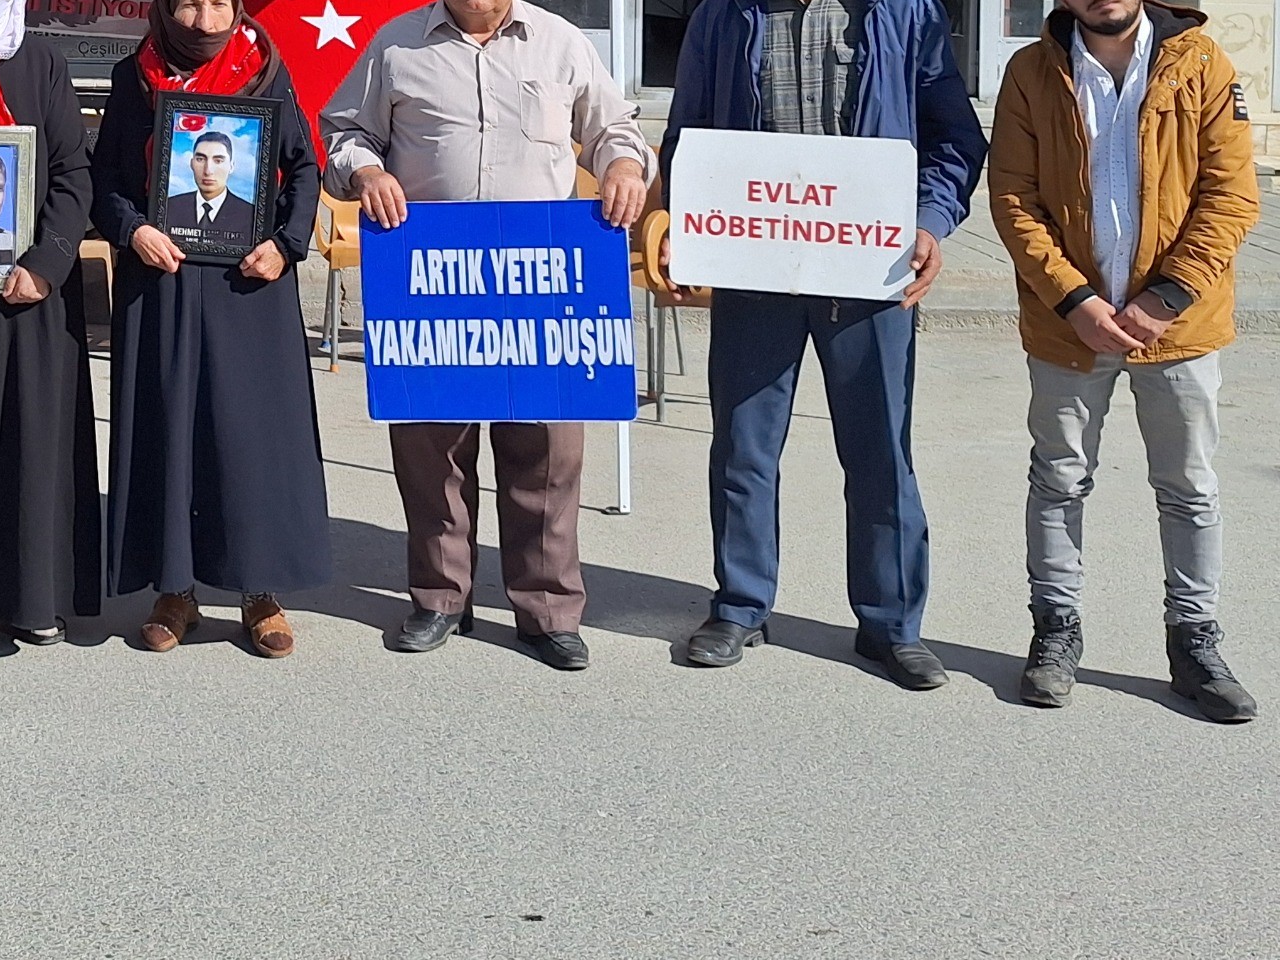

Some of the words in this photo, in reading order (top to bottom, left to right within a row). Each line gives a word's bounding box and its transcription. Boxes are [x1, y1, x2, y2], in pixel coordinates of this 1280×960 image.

[746, 180, 838, 207] EVLAT
[683, 212, 902, 249] NÖBETİNDEYİZ
[409, 248, 484, 295] ARTIK
[489, 247, 569, 294] YETER
[575, 247, 583, 294] !
[366, 319, 538, 367] YAKAMIZDAN
[545, 305, 634, 380] DÜŞÜN
